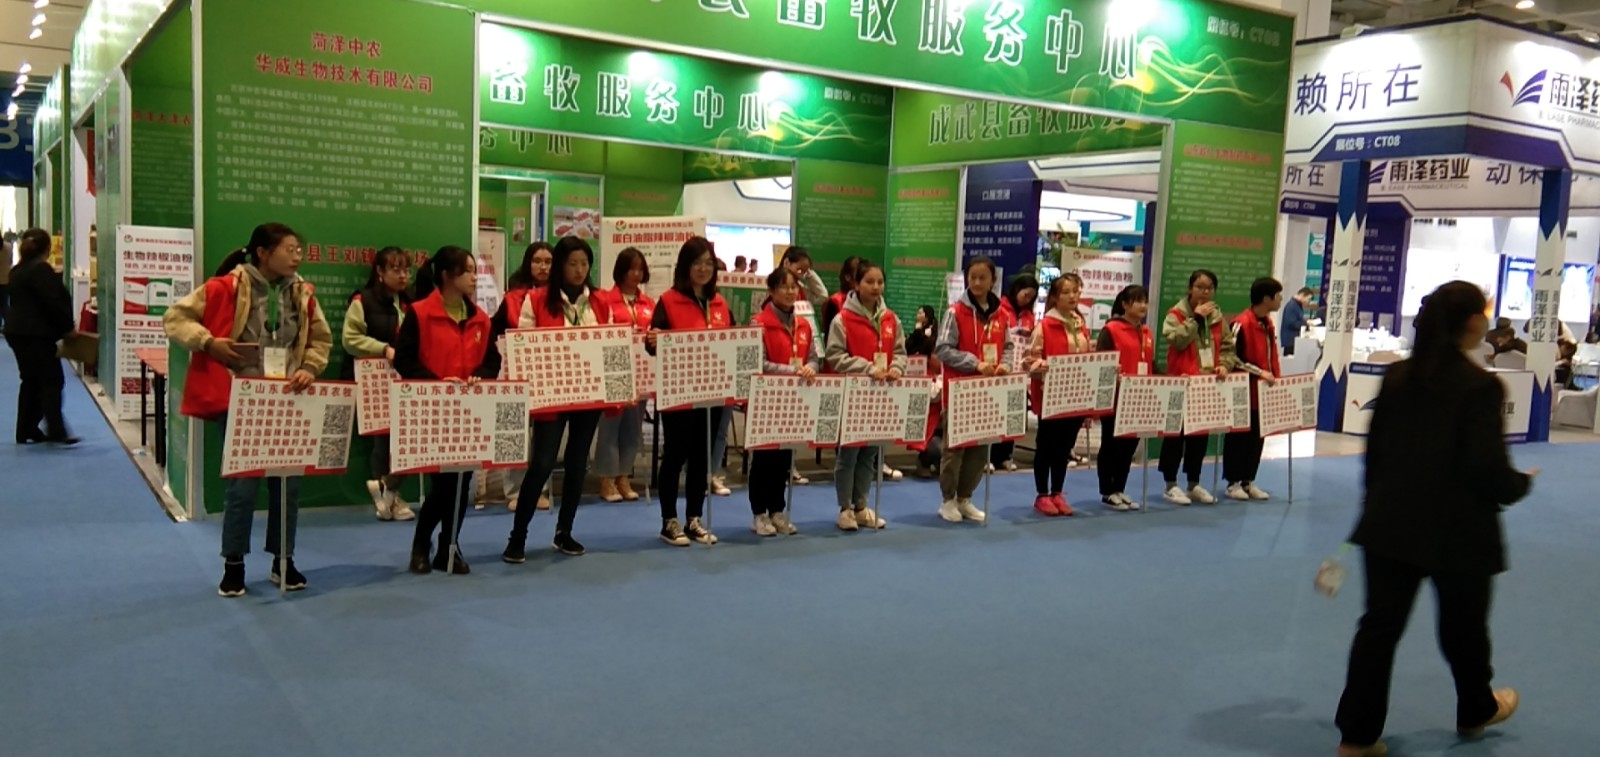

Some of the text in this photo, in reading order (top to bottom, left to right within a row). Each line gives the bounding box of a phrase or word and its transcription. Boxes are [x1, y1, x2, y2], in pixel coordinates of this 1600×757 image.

[312, 32, 381, 57] 菏泽中农
[699, 0, 1139, 80] 畜牧服务中心
[256, 53, 433, 93] 华威生物技术有限公司
[1294, 64, 1422, 115] 赖所在
[928, 100, 1126, 146] 成武县畜牧服
[1284, 165, 1325, 187] 所在
[1390, 157, 1471, 181] 雨泽药业
[123, 250, 192, 264] 生物辣椒油粉
[1328, 280, 1345, 332] 雨泽药业
[1531, 289, 1549, 342] 雨泽药业
[528, 329, 627, 344] 山东泰安泰西农牧
[675, 331, 758, 344] 山东泰安泰西农牧
[416, 384, 524, 396] 山东泰安泰西农牧
[399, 399, 461, 408] 生物辣椒油粉
